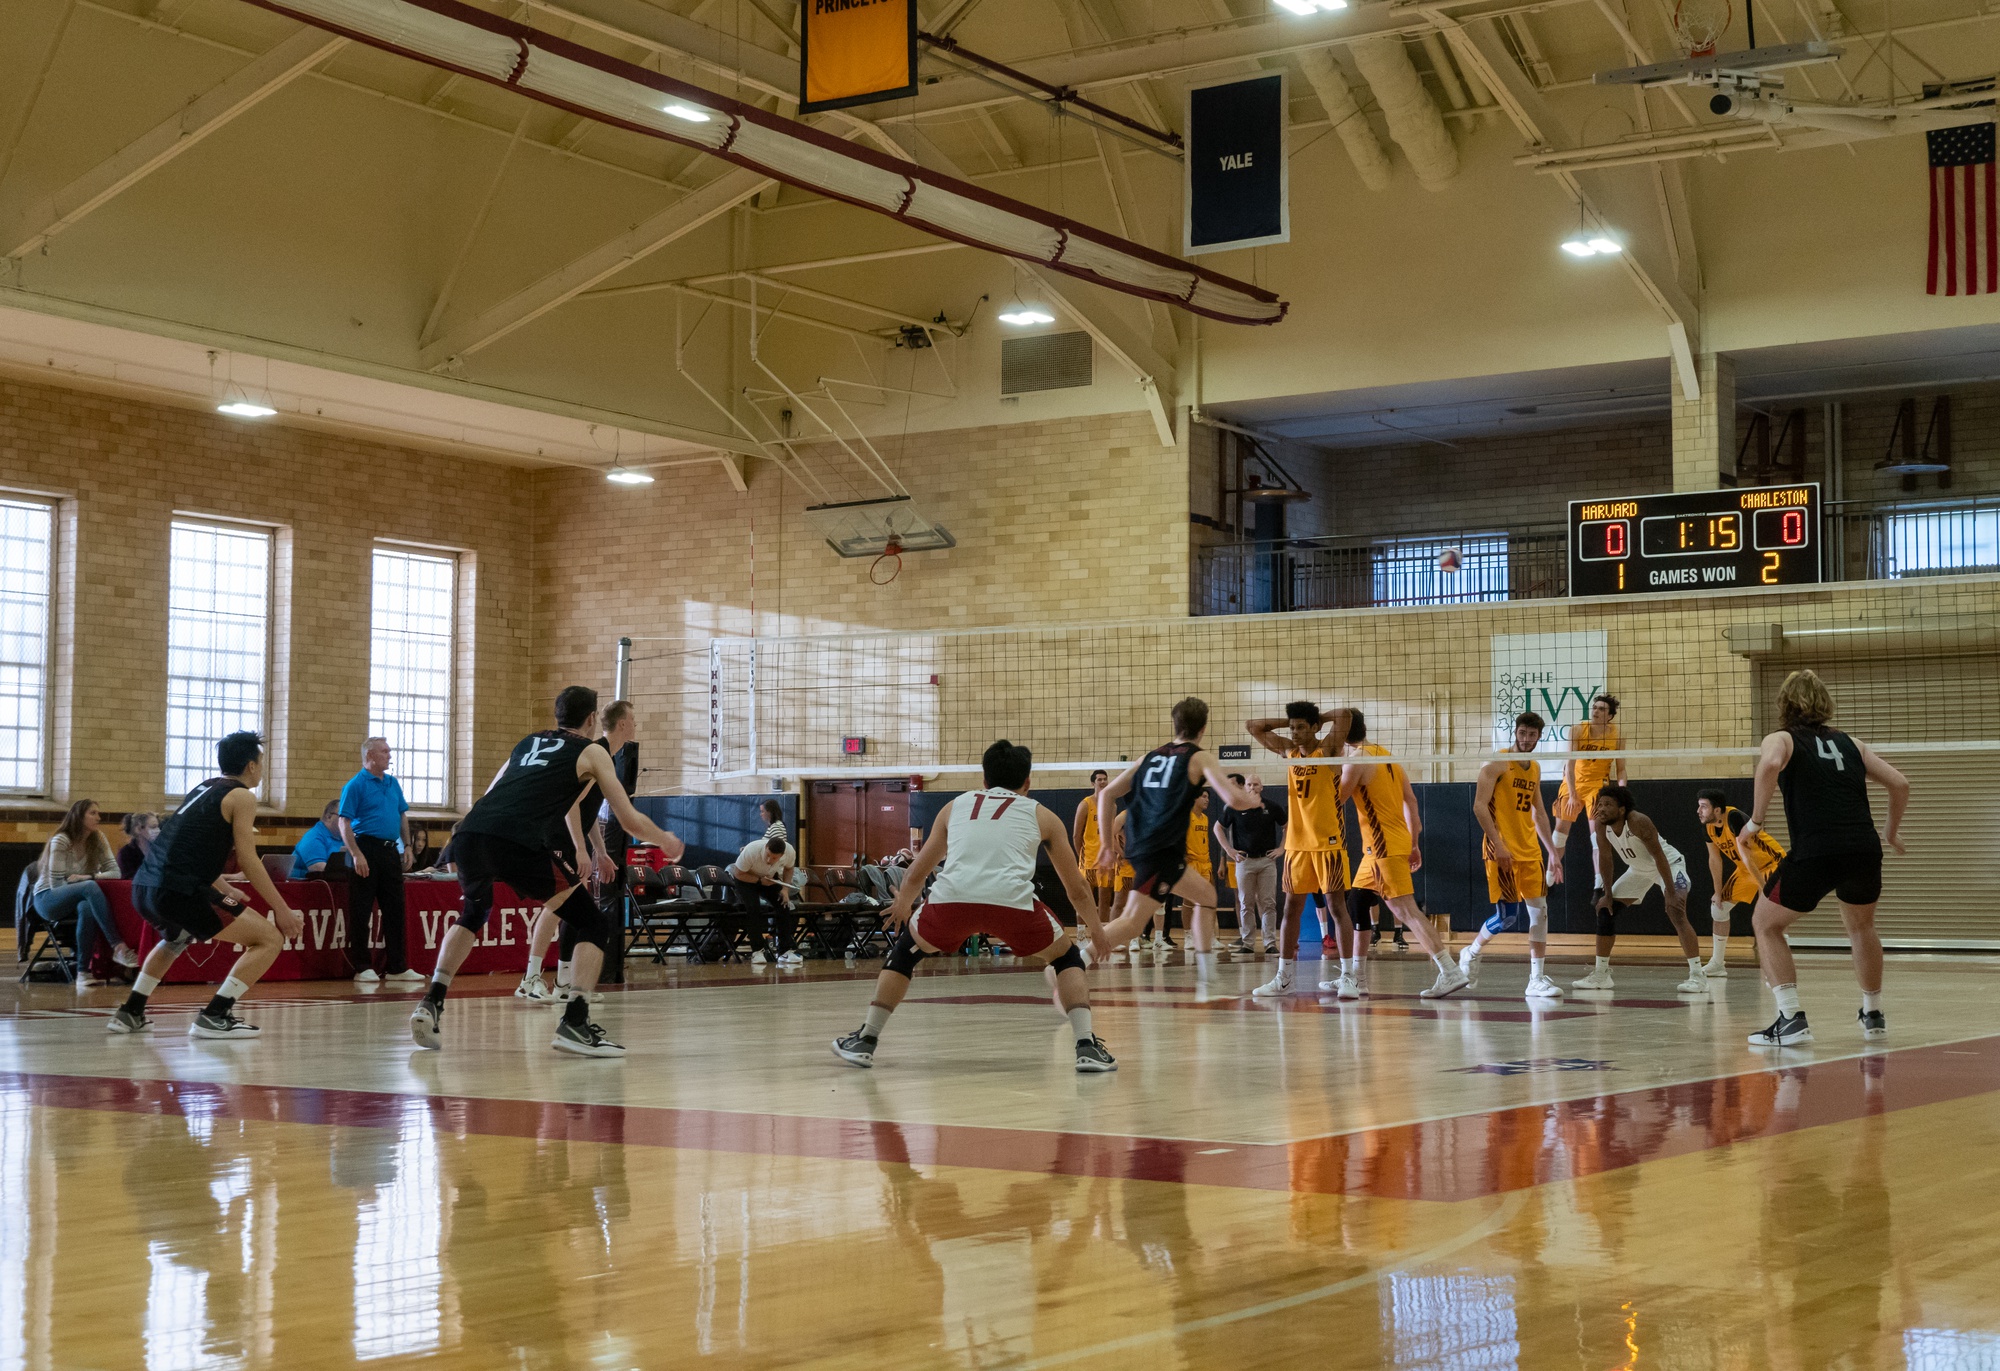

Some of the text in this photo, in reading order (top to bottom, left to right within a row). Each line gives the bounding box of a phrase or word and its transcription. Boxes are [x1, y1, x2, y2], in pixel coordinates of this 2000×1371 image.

[1219, 152, 1253, 171] YALE
[1582, 502, 1638, 520] HARVARD
[1741, 489, 1808, 509] CHARLESTON
[1606, 524, 1624, 555] 0
[1783, 512, 1801, 544] 0
[1618, 563, 1624, 590] 1
[1649, 566, 1736, 586] GAMES WON
[1762, 552, 1780, 583] 2
[1520, 671, 1554, 684] THE
[1522, 685, 1602, 722] IVY
[520, 736, 565, 767] 12
[1815, 735, 1845, 771] 4
[1143, 755, 1177, 788] 21
[970, 793, 1016, 820] 17
[1621, 847, 1636, 859] 10
